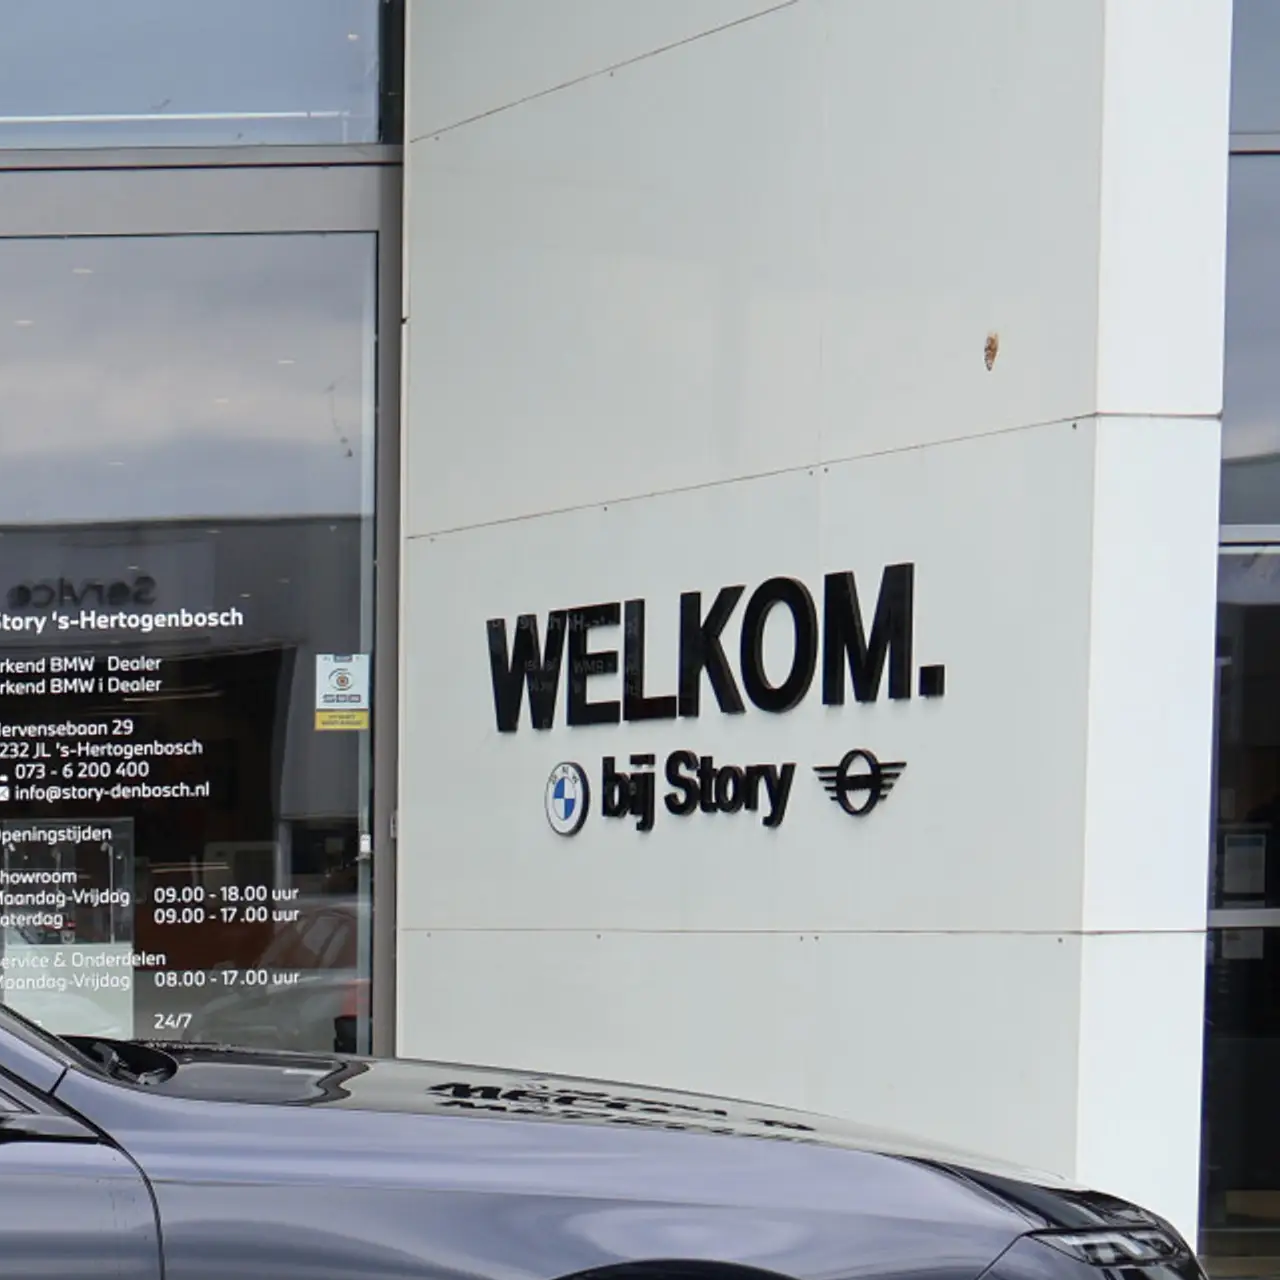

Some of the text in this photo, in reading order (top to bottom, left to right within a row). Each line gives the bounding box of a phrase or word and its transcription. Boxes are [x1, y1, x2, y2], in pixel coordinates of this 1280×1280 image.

[52, 608, 244, 633] 's-Hertogenbosch
[486, 562, 945, 733] WELKOM.
[50, 656, 95, 673] BMW
[107, 655, 162, 672] Dealer
[50, 678, 95, 694] BMW
[98, 678, 103, 692] i
[107, 677, 162, 692] Dealer
[112, 719, 134, 735] 29
[32, 742, 52, 759] JL
[56, 739, 203, 760] 's-Hertogenbosch
[15, 763, 46, 779] 073
[62, 763, 74, 778] 6
[77, 762, 111, 778] 200
[115, 761, 150, 778] 400
[15, 781, 210, 803] info@story-denbosch.nl
[602, 750, 797, 833] bij Story
[154, 886, 205, 904] 09.00
[220, 885, 268, 902] 18.00
[271, 888, 299, 901] uur
[154, 907, 205, 924] 09.00
[220, 906, 268, 923] 17.00
[272, 909, 300, 922] uur
[53, 952, 67, 969] &
[71, 950, 167, 969] Onderdelen
[154, 971, 206, 988] 08.00
[221, 969, 269, 986] 17.00
[272, 971, 301, 985] uur
[154, 1012, 193, 1030] 24/7
